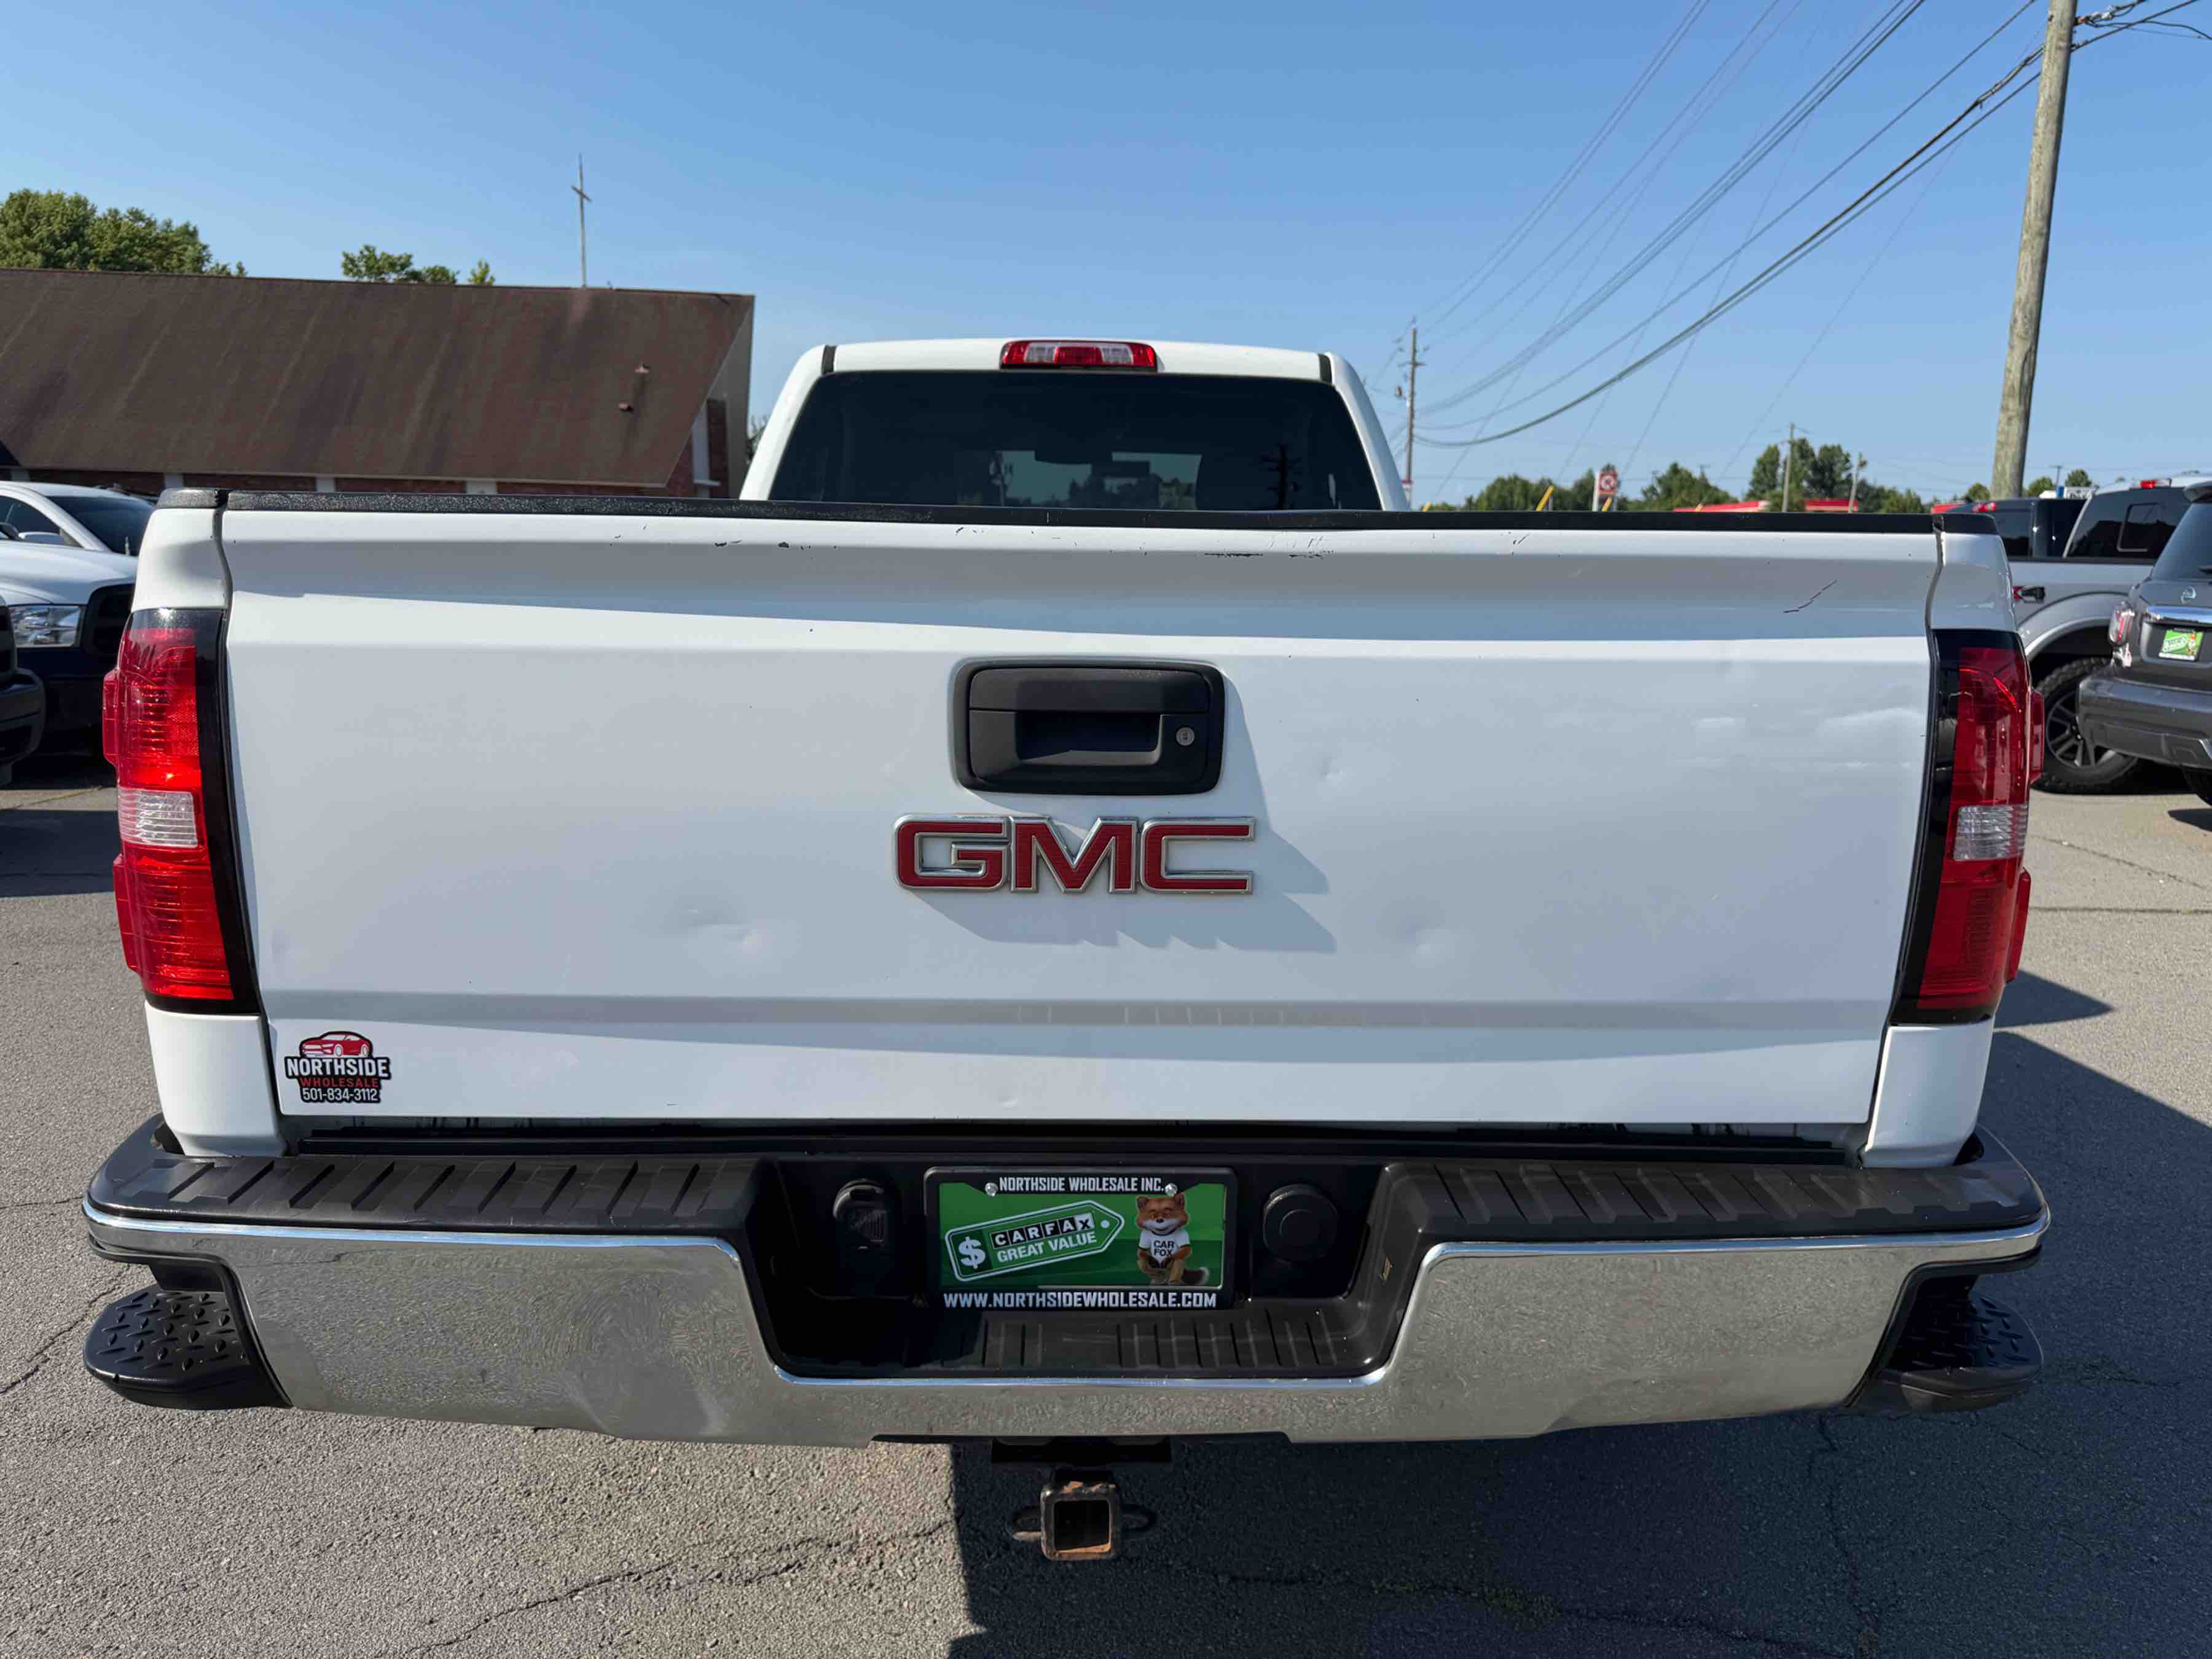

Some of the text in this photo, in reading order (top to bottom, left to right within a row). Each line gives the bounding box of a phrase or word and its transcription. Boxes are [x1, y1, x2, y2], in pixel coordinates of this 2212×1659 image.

[895, 814, 1255, 894] GMC
[286, 1058, 389, 1077] NORTHSIDE
[300, 1078, 379, 1088] WHOLESALE
[303, 1088, 378, 1101] 501-834-3112
[998, 1177, 1164, 1192] NORTHSIDE WHOLESALE INC.
[994, 1217, 1092, 1247] CARFAX
[997, 1231, 1097, 1263] GREAT VALUE
[1153, 1240, 1175, 1249] CAR
[1153, 1248, 1173, 1257] FOX
[944, 1292, 1217, 1309] WWW.NORTHSIDEWHOLESALE.COM
